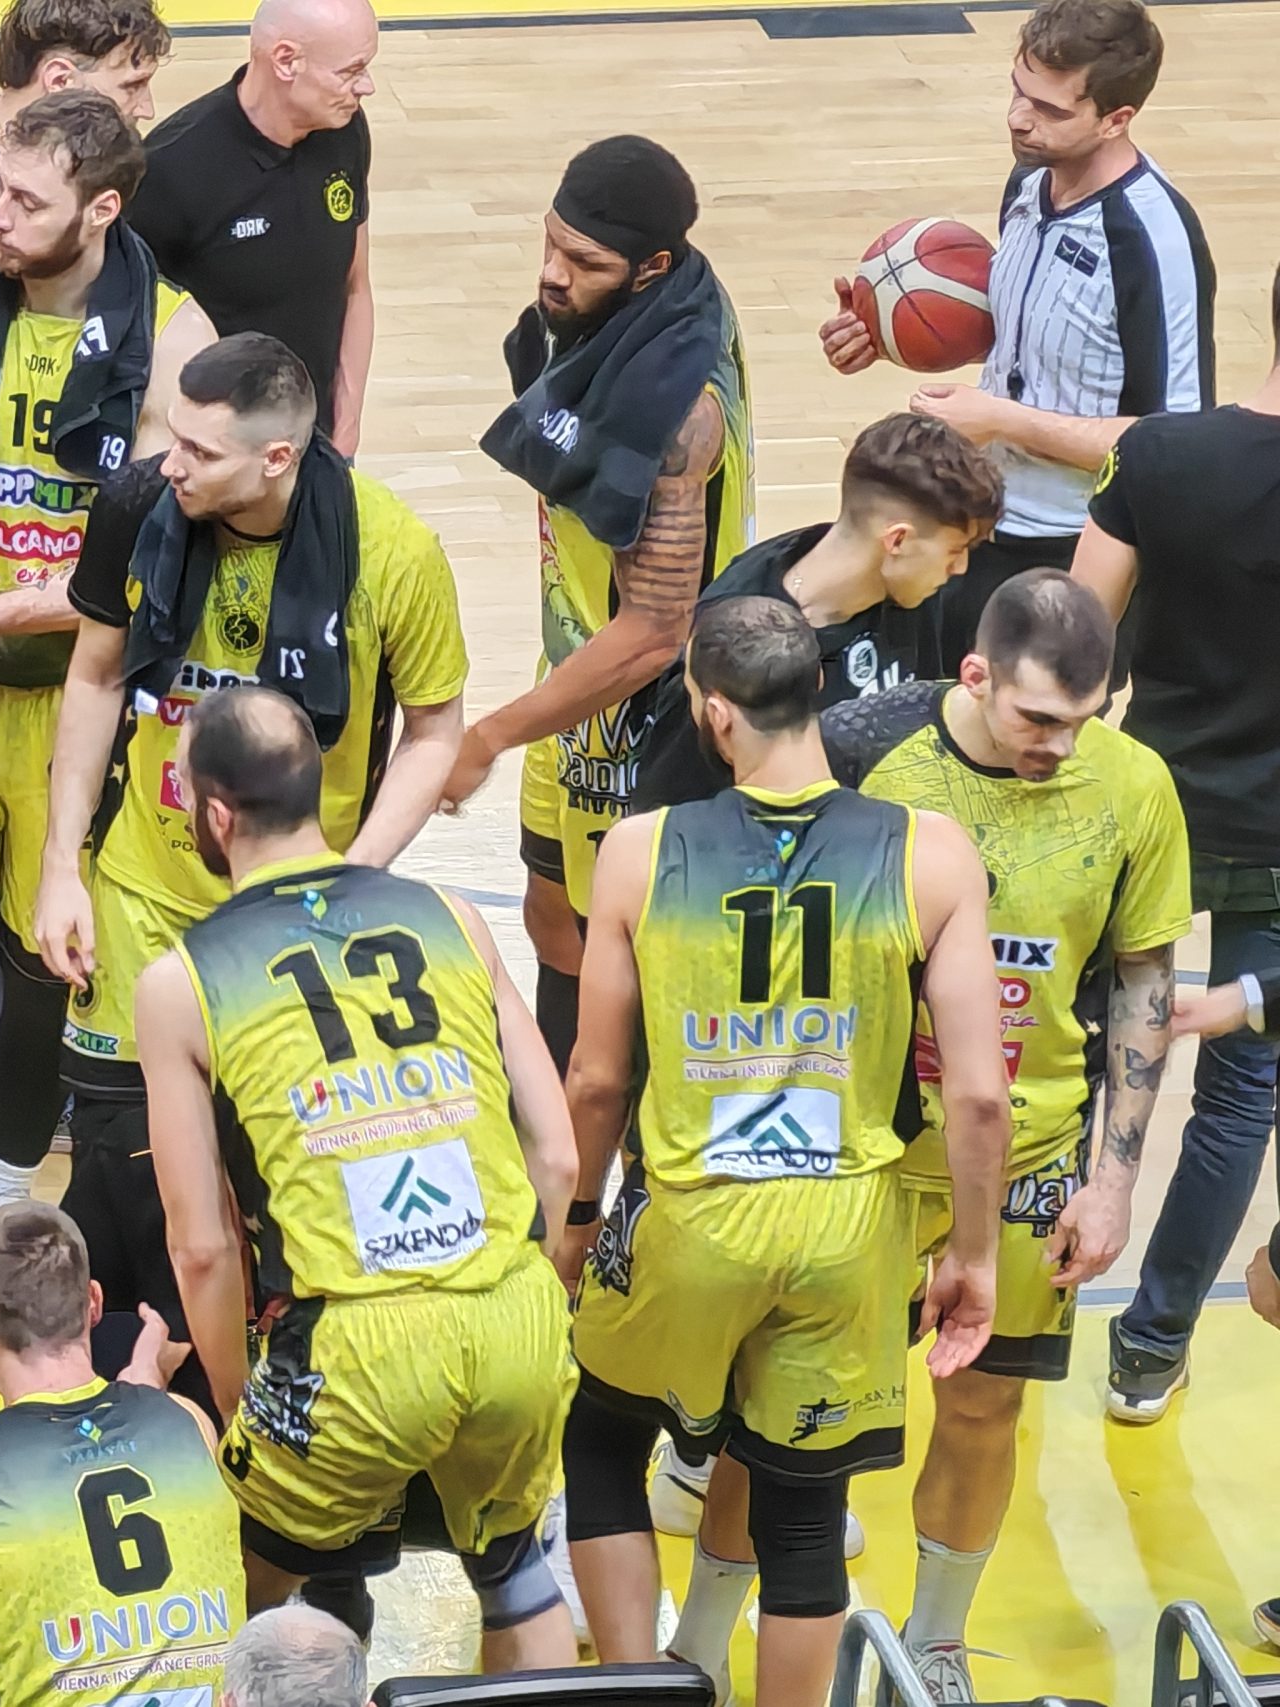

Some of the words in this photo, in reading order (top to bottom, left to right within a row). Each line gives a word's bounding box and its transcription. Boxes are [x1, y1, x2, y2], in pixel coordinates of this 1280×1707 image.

[8, 393, 58, 454] 19
[98, 435, 126, 470] 19
[724, 882, 834, 1004] 11
[269, 928, 442, 1065] 13
[685, 1005, 857, 1051] UNION
[289, 1045, 472, 1123] UNION
[76, 1465, 174, 1598] 6
[42, 1589, 229, 1661] UNION
[55, 1673, 110, 1691] VIENNA
